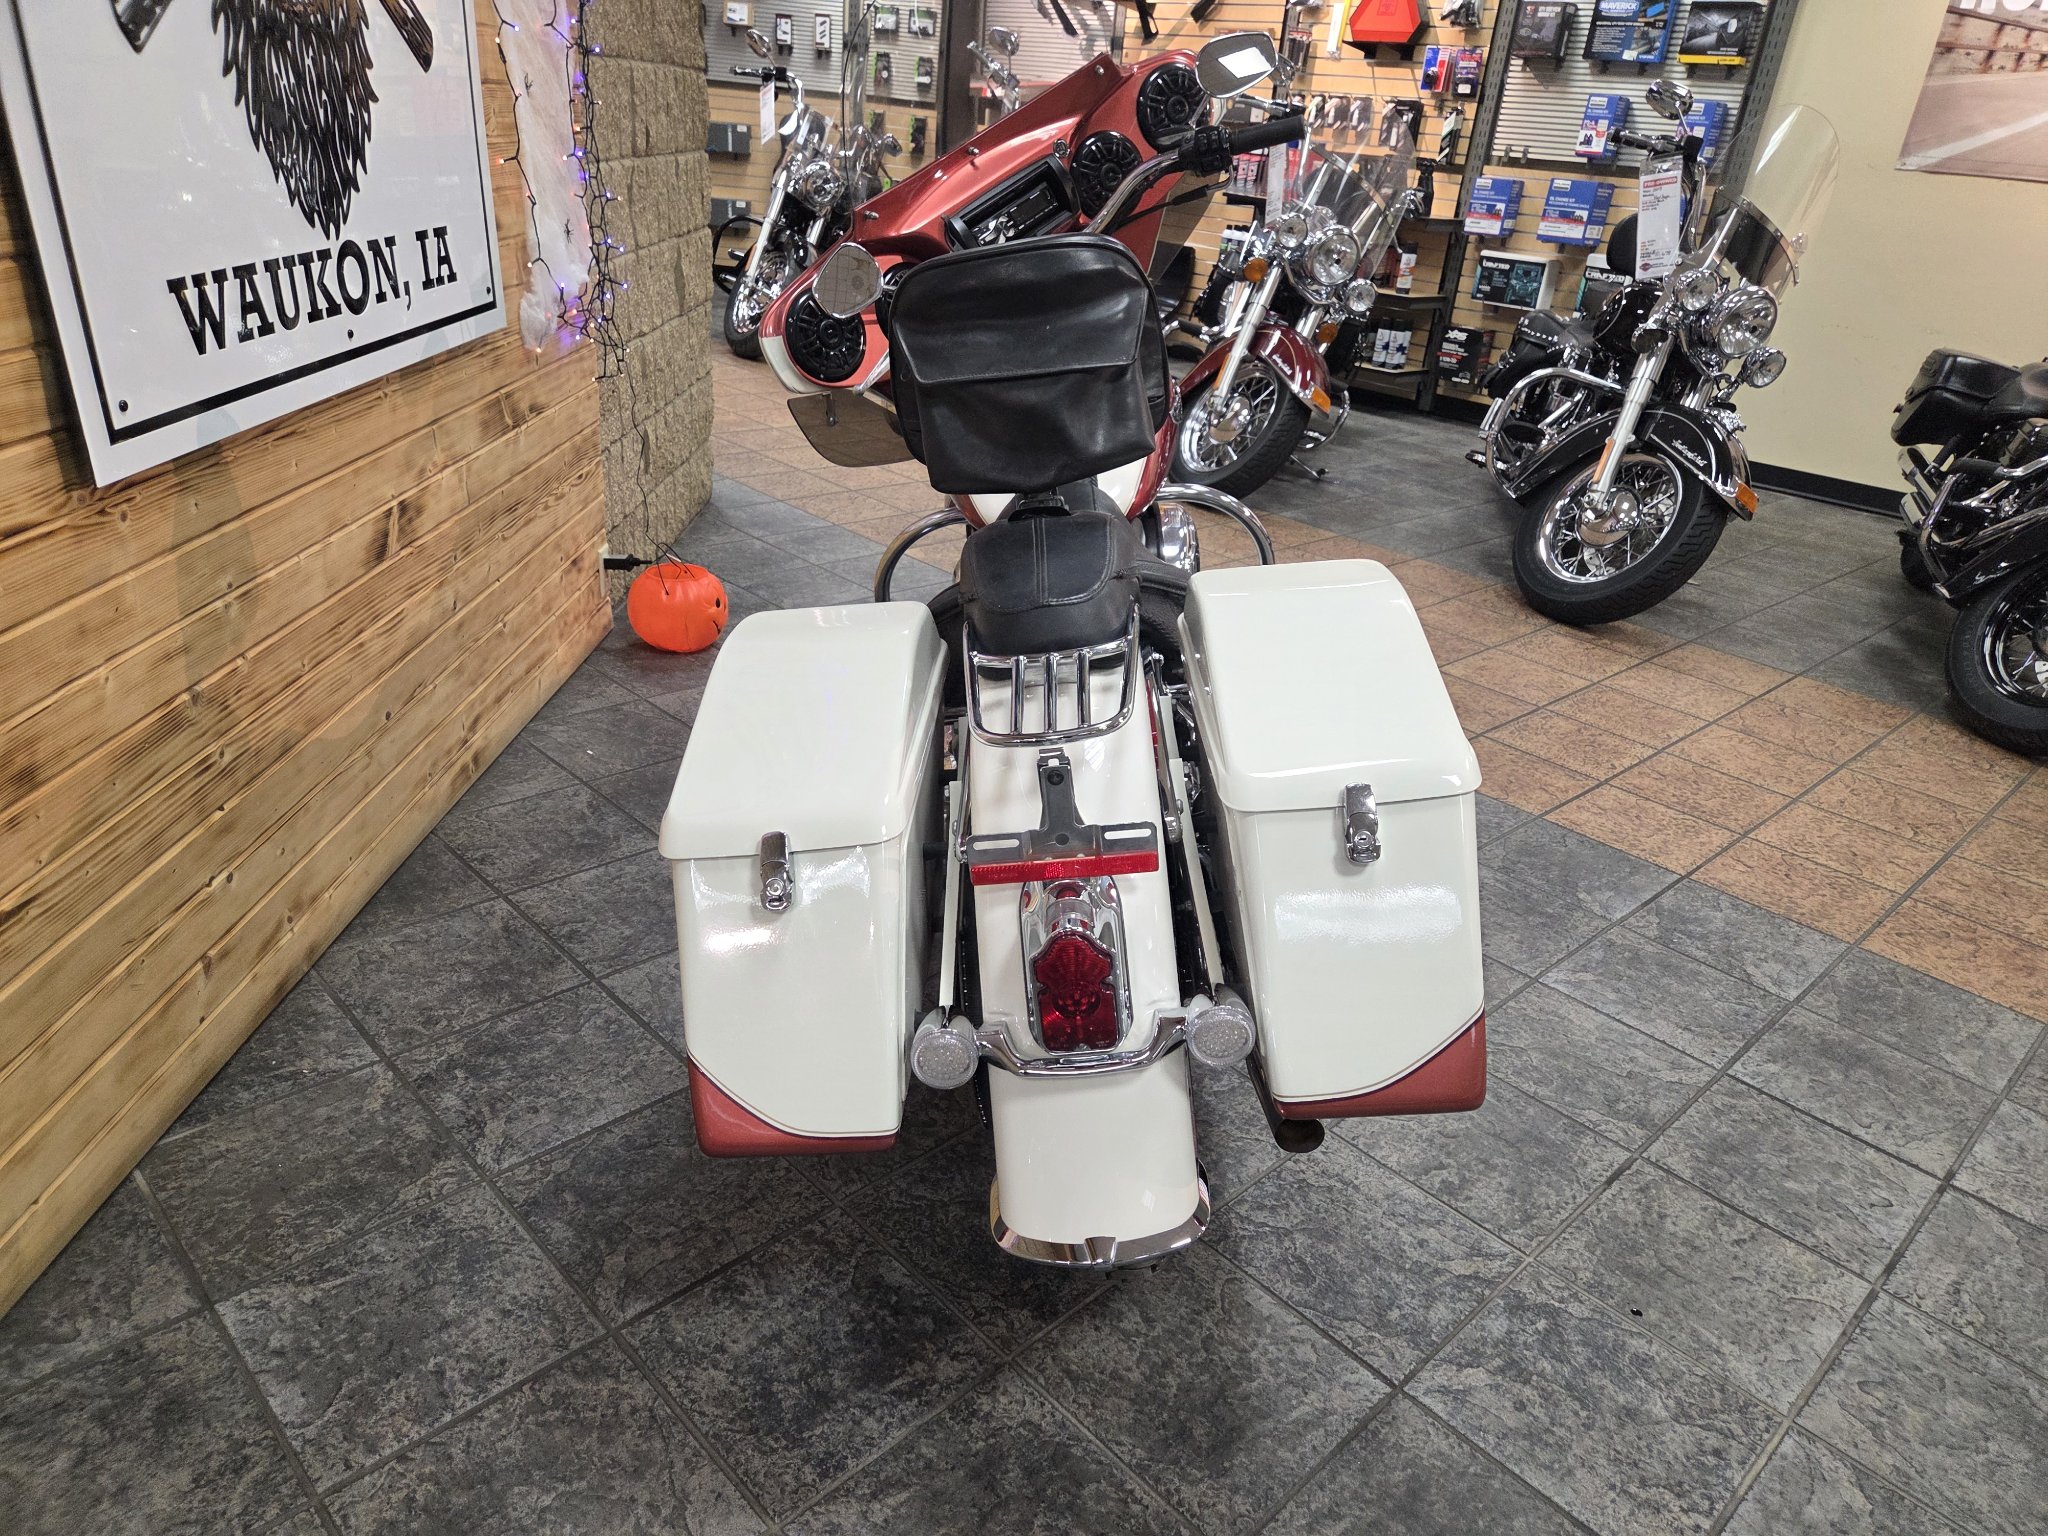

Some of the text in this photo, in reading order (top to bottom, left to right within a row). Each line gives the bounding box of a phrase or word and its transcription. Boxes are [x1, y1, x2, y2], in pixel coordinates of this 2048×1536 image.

[1600, 1, 1637, 10] MAVERICK
[166, 226, 457, 355] WAUKON, IA
